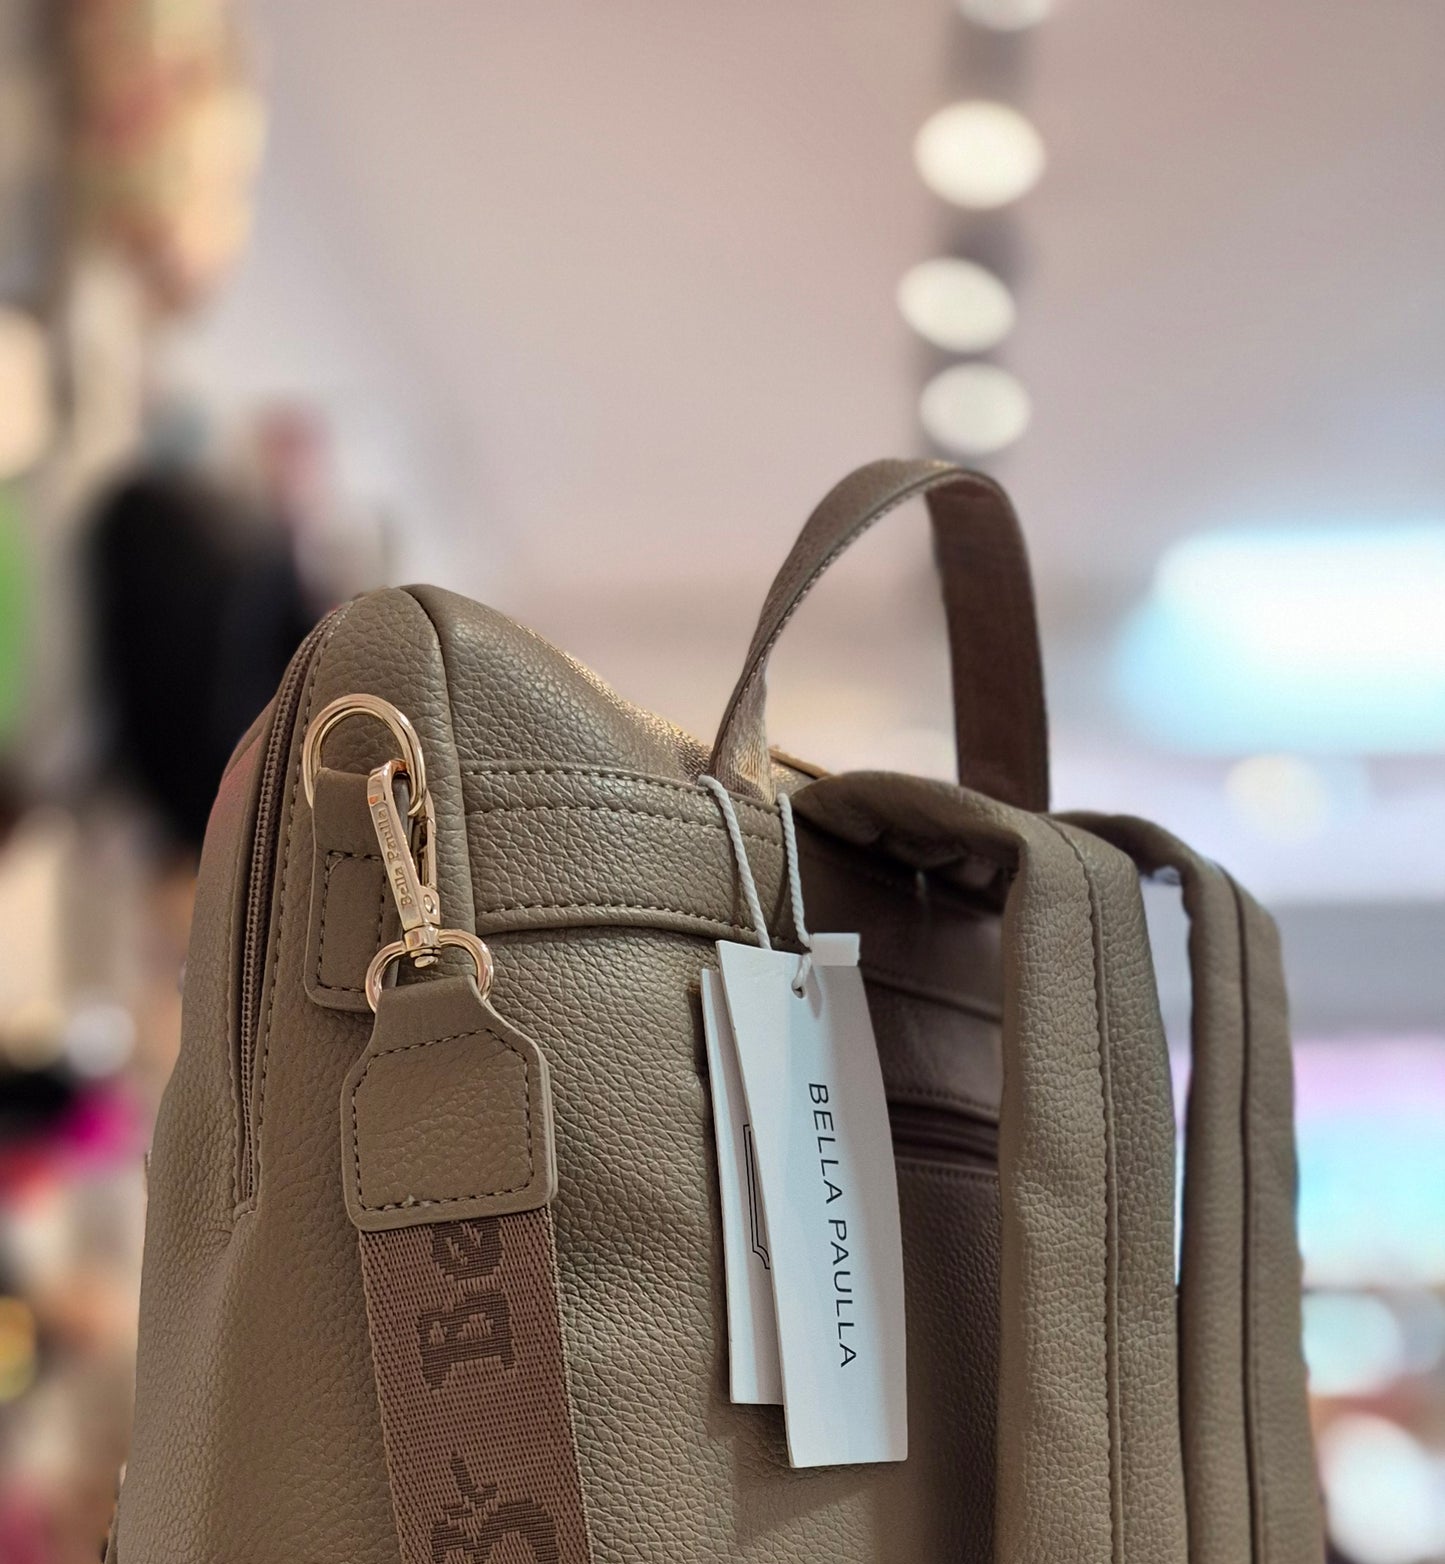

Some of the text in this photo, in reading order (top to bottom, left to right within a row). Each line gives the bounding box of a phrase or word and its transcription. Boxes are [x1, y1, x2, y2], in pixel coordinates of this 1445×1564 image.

[377, 808, 413, 909] Bella Paulla
[807, 1083, 857, 1368] BELLA PAULLA
